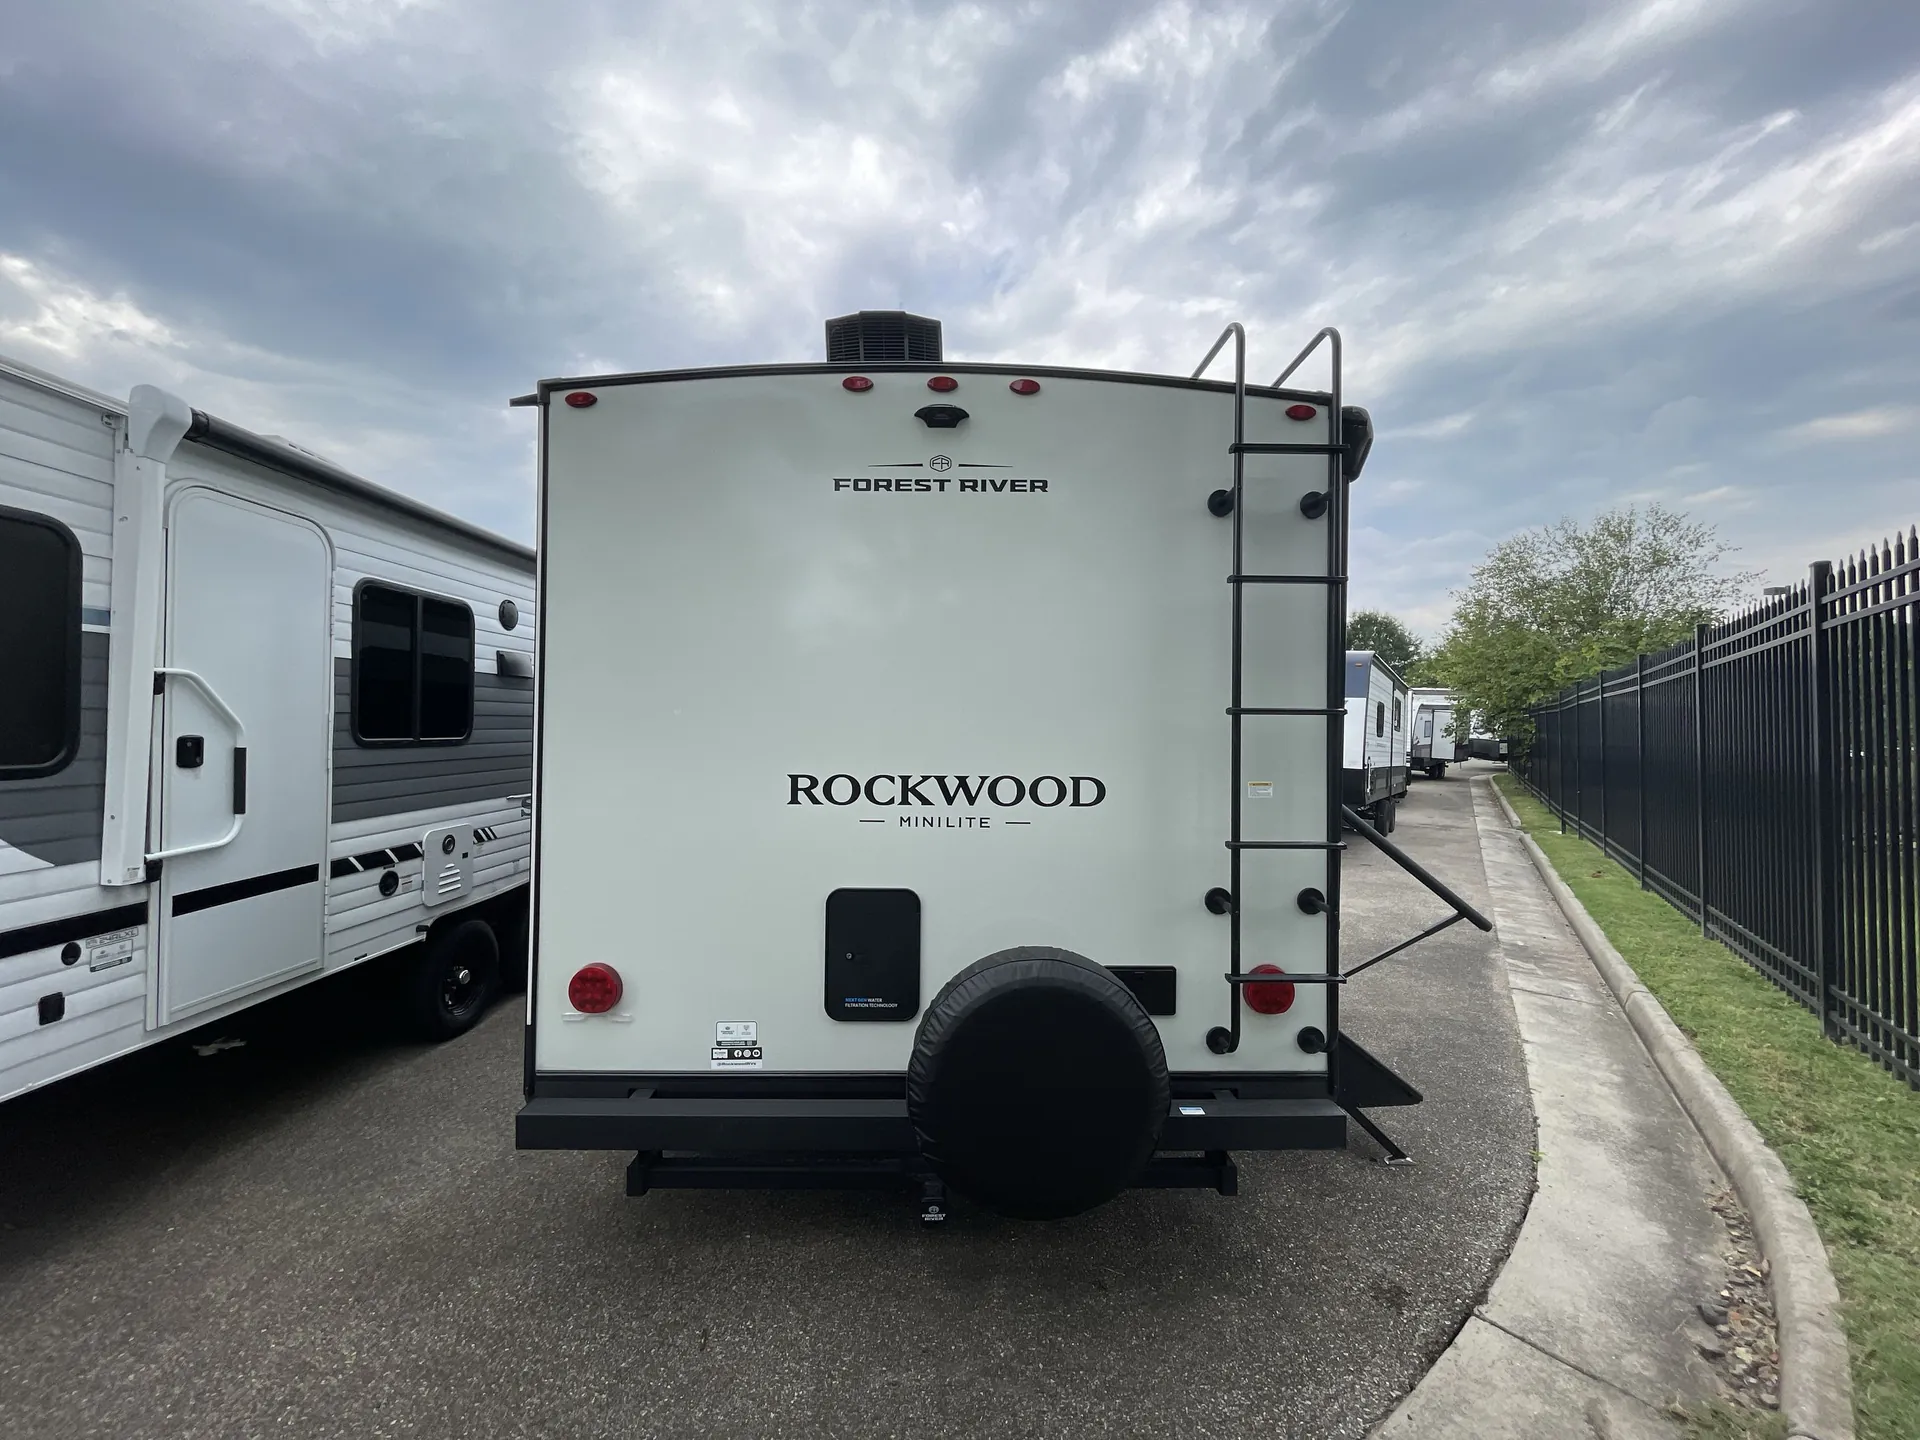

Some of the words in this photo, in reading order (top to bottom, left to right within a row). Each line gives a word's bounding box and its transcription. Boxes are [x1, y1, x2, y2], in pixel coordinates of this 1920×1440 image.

[833, 478, 951, 492] FOREST
[958, 478, 1048, 493] RIVER
[787, 774, 1106, 807] ROCKWOOD
[900, 816, 990, 828] MINILITE
